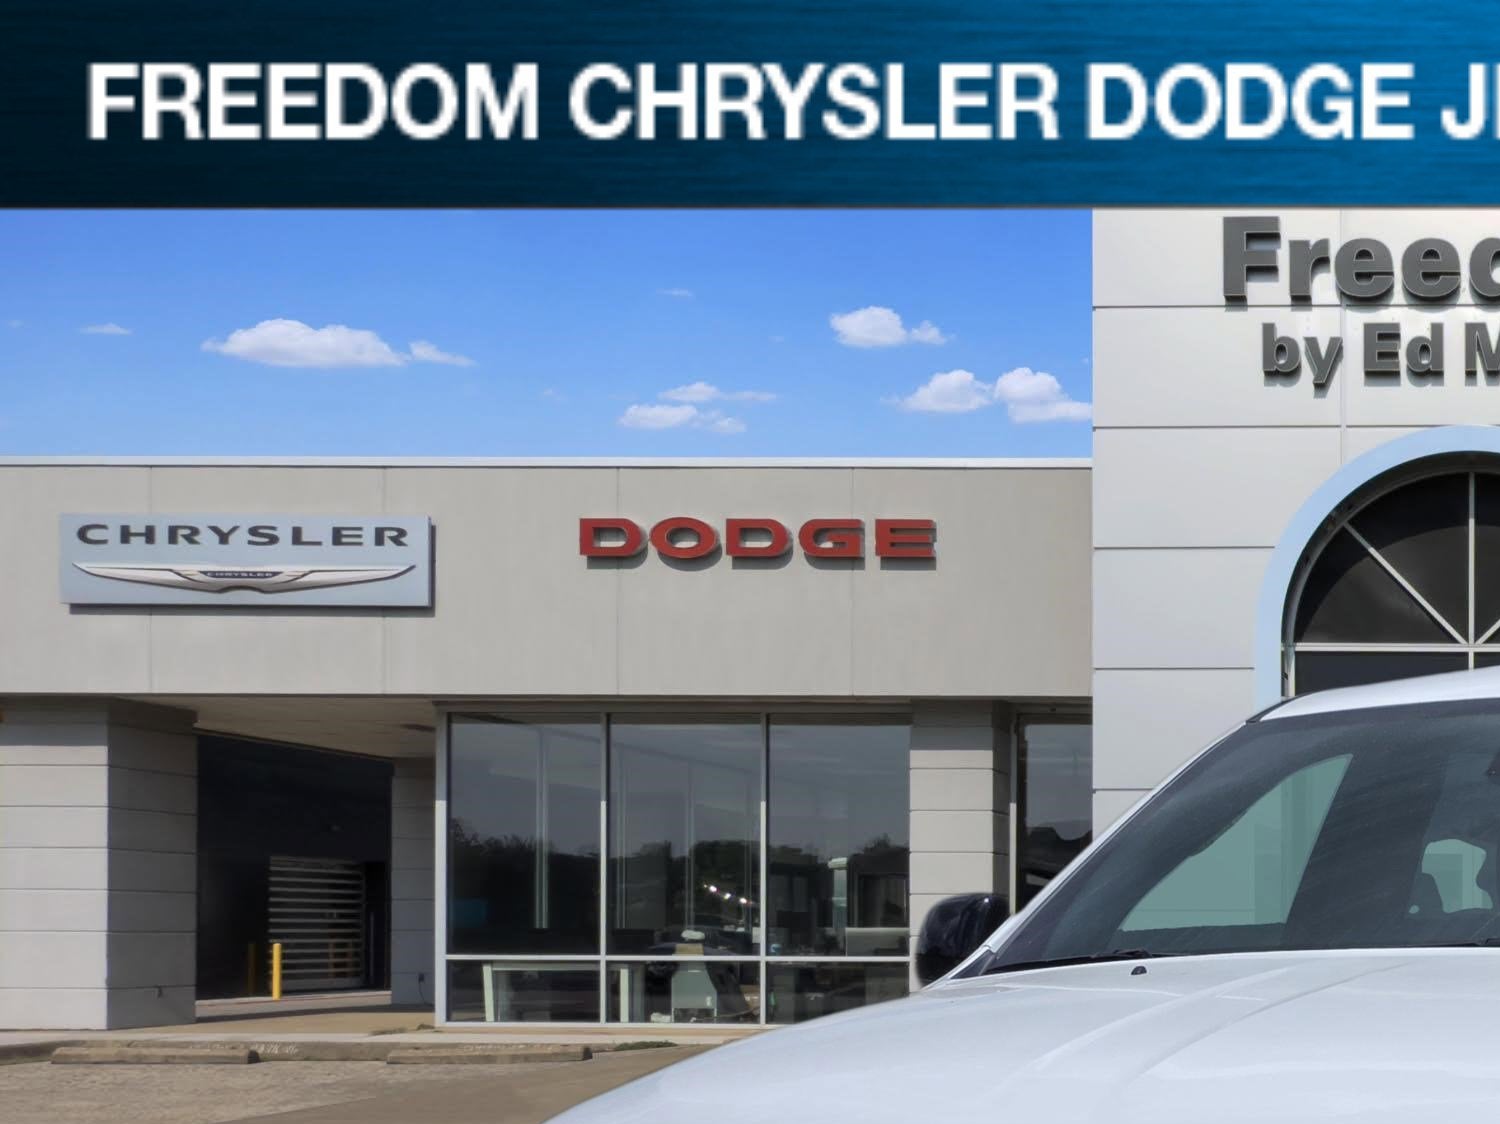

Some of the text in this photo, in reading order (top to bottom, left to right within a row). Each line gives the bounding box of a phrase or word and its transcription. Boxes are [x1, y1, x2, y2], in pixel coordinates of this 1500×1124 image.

[1262, 322, 1343, 390] by
[1363, 322, 1445, 376] Ed
[76, 523, 409, 548] CHRYSLER
[579, 517, 936, 560] DODGE
